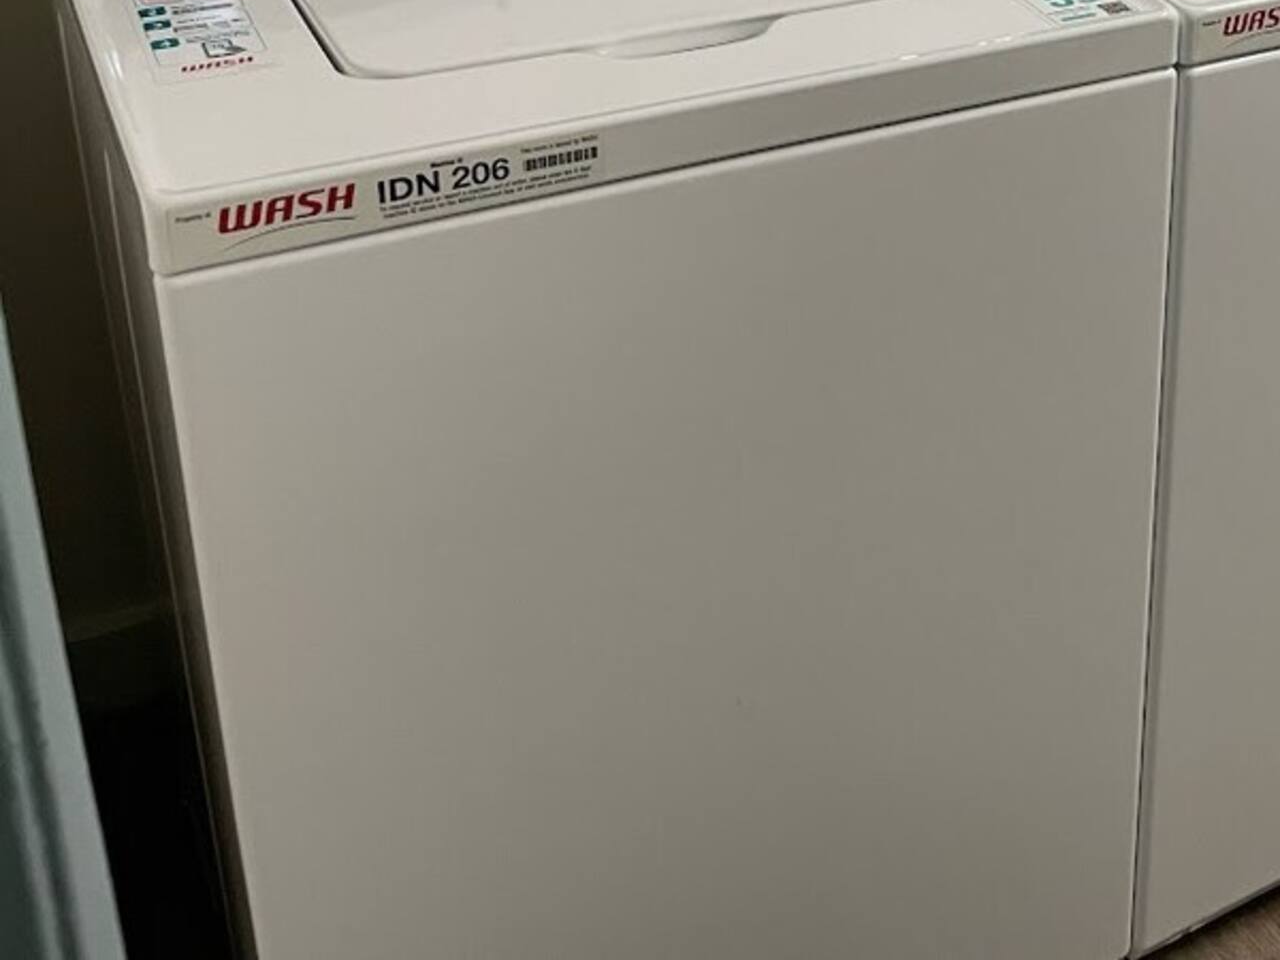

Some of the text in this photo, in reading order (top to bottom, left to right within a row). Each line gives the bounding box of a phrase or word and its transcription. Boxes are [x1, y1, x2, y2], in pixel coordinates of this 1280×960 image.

[217, 182, 356, 235] WASH
[376, 169, 441, 206] IDN
[451, 156, 511, 191] 206
